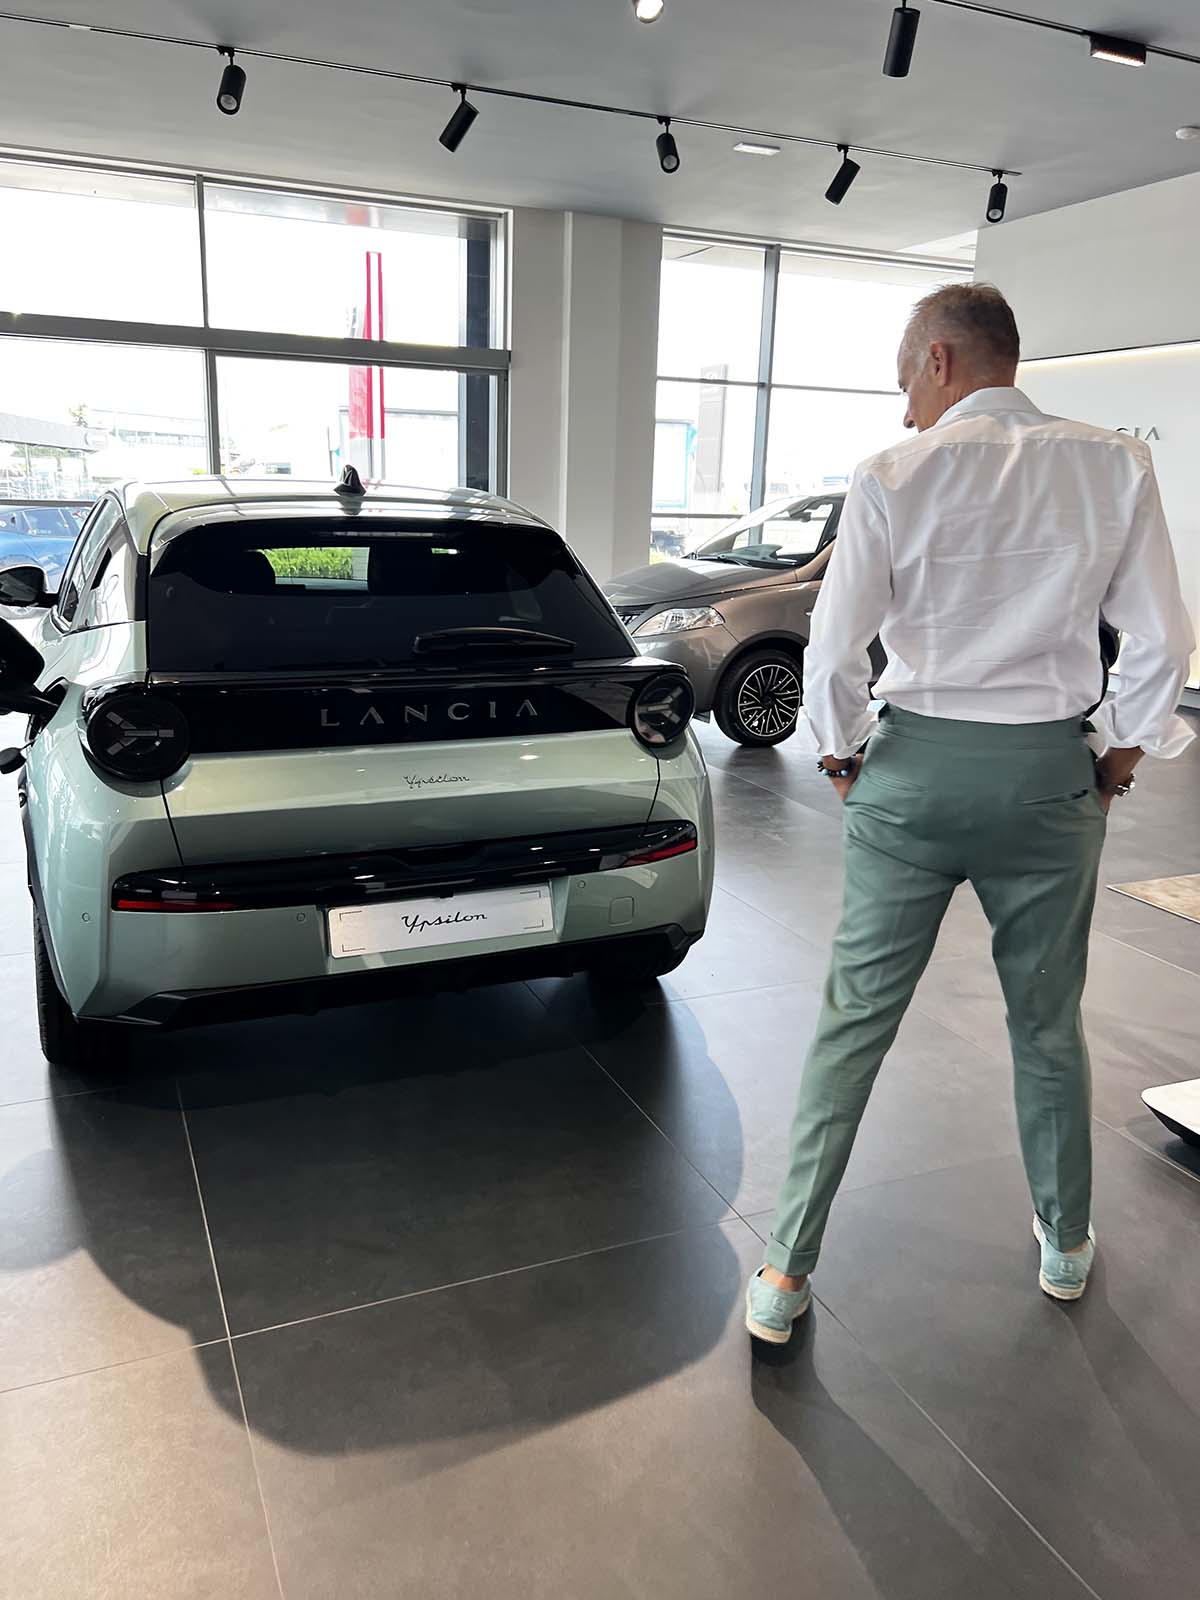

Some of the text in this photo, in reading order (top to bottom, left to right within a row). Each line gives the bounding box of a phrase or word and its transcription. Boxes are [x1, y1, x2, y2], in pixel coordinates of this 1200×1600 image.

[320, 699, 538, 727] LANCIA
[403, 773, 470, 790] Ypsilon
[401, 911, 488, 935] Ypsilon
